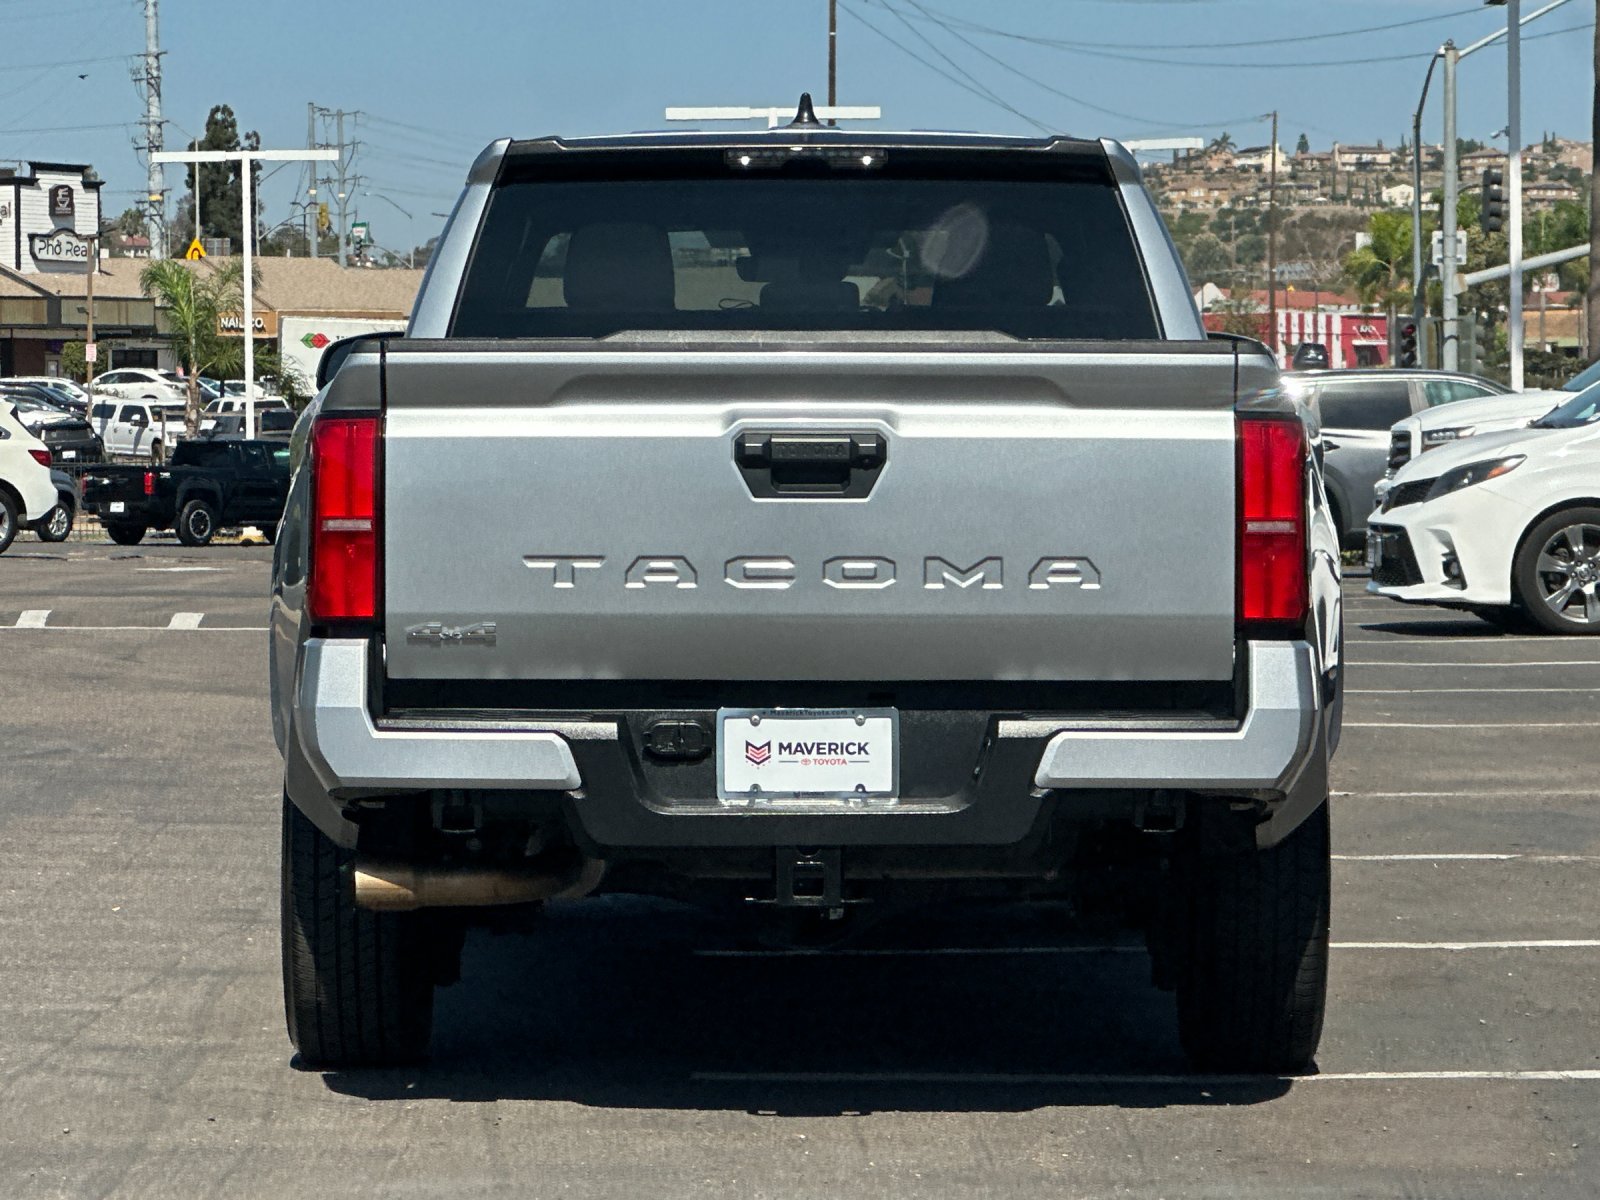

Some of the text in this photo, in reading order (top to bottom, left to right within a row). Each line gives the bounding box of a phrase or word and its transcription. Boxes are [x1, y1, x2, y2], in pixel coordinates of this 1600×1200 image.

[0, 201, 11, 218] al
[65, 241, 91, 257] Rea
[522, 554, 1102, 590] TACOMA
[778, 742, 870, 756] MAVERICK
[813, 758, 848, 766] TOYOTA
